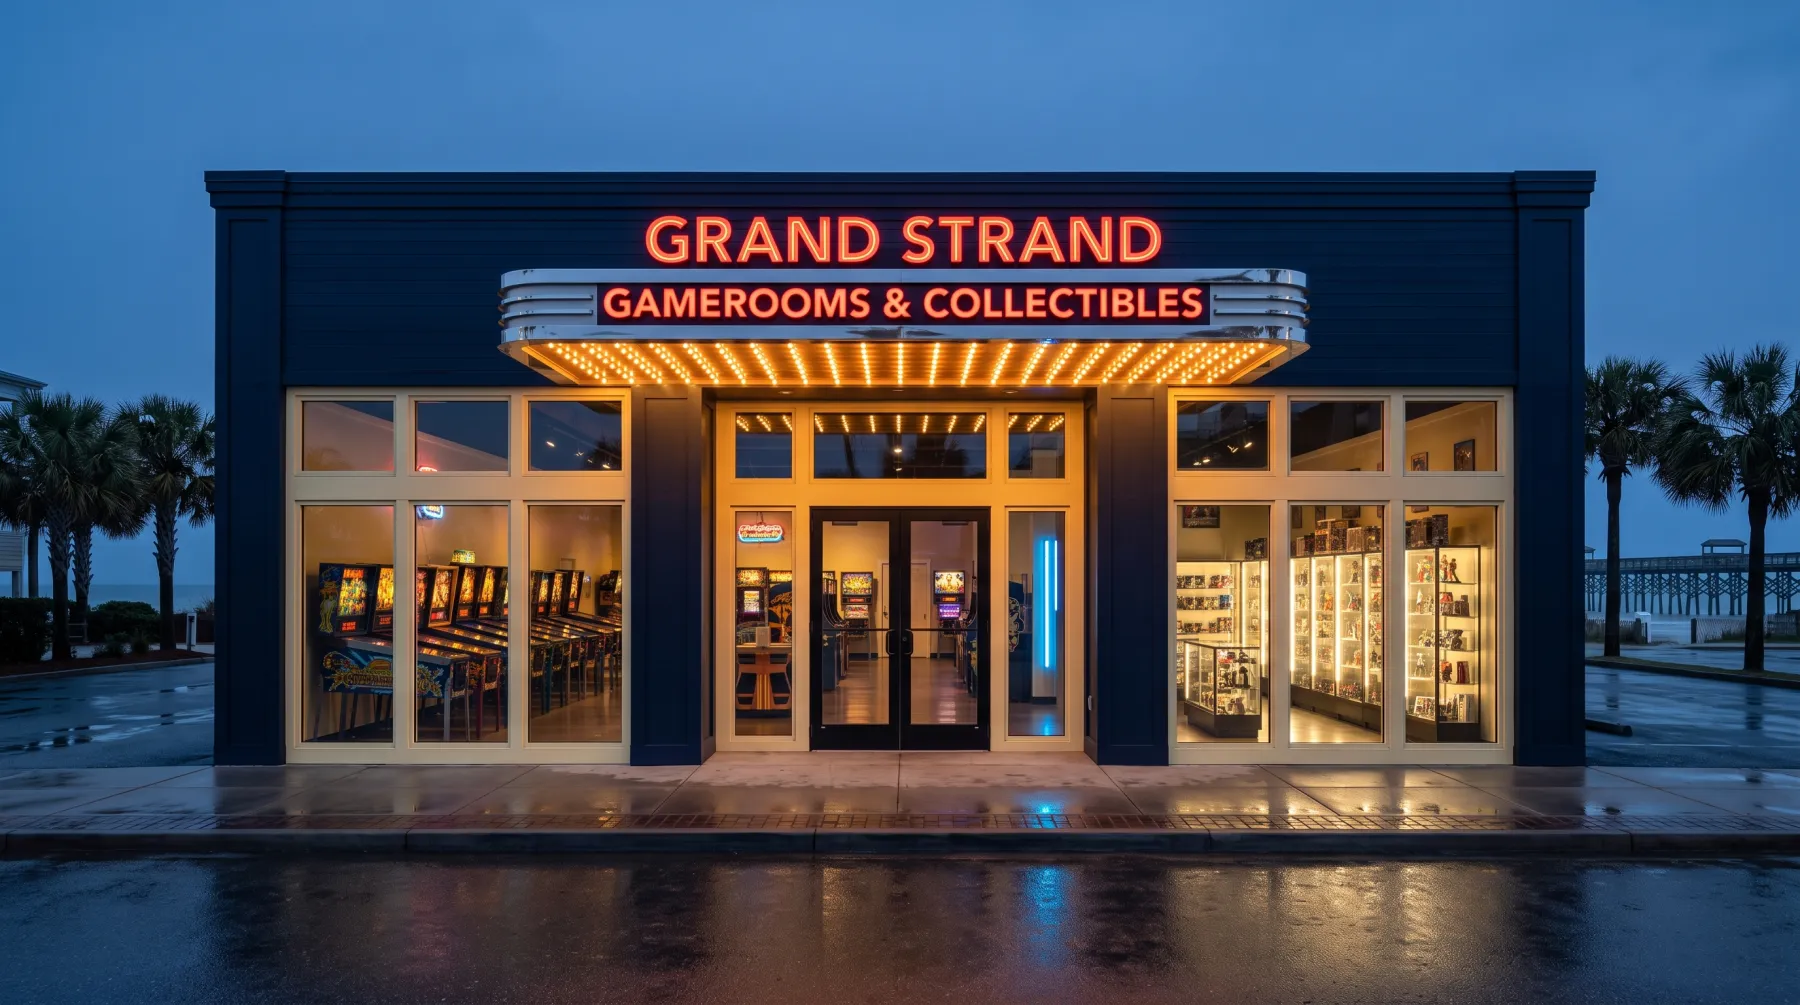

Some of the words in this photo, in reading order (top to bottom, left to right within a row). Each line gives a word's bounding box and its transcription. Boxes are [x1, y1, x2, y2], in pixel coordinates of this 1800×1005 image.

[645, 215, 880, 263] GRAND
[901, 215, 1162, 263] STRAND
[603, 287, 870, 318] GAMEROOMS
[883, 287, 911, 318] &
[923, 287, 1203, 318] COLLECTIBLES
